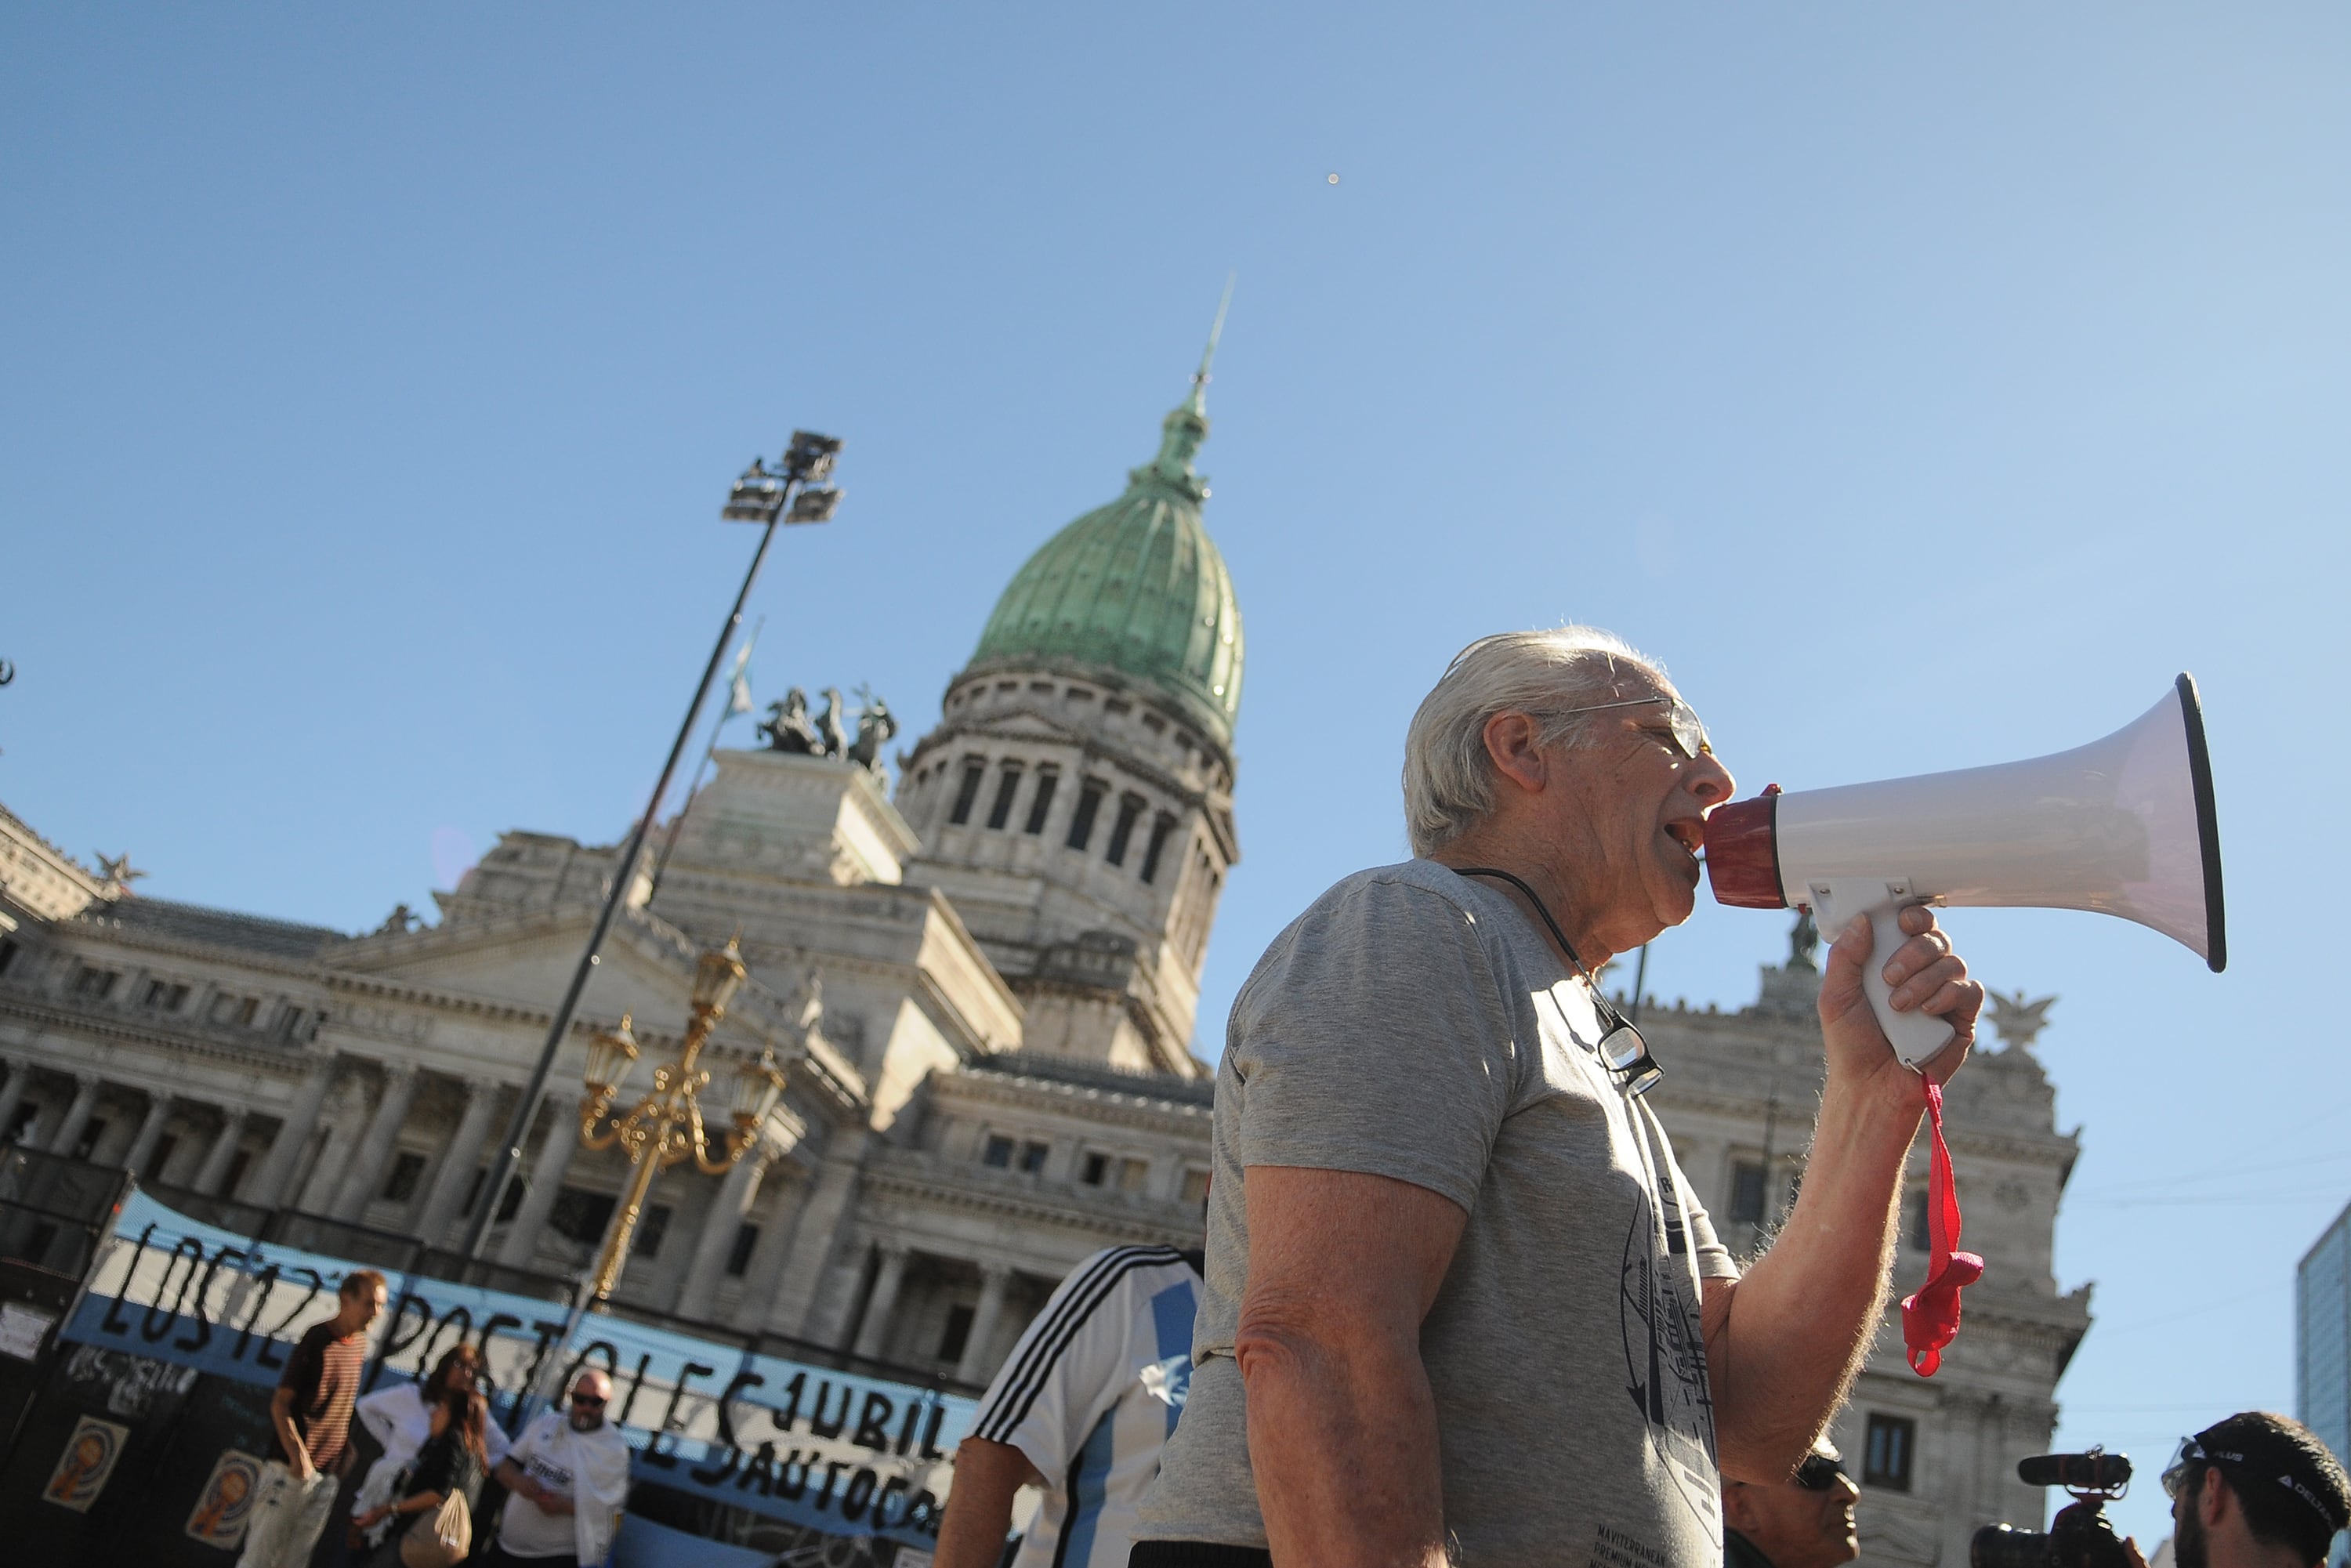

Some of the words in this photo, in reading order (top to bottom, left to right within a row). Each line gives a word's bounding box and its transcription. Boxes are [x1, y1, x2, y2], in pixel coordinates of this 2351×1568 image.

[102, 1222, 249, 1351] LOS
[232, 1263, 323, 1369] 12
[359, 1294, 766, 1487] POSTOLES
[771, 1372, 944, 1460] JUBIL
[1593, 1541, 1632, 1568] PREMIUM
